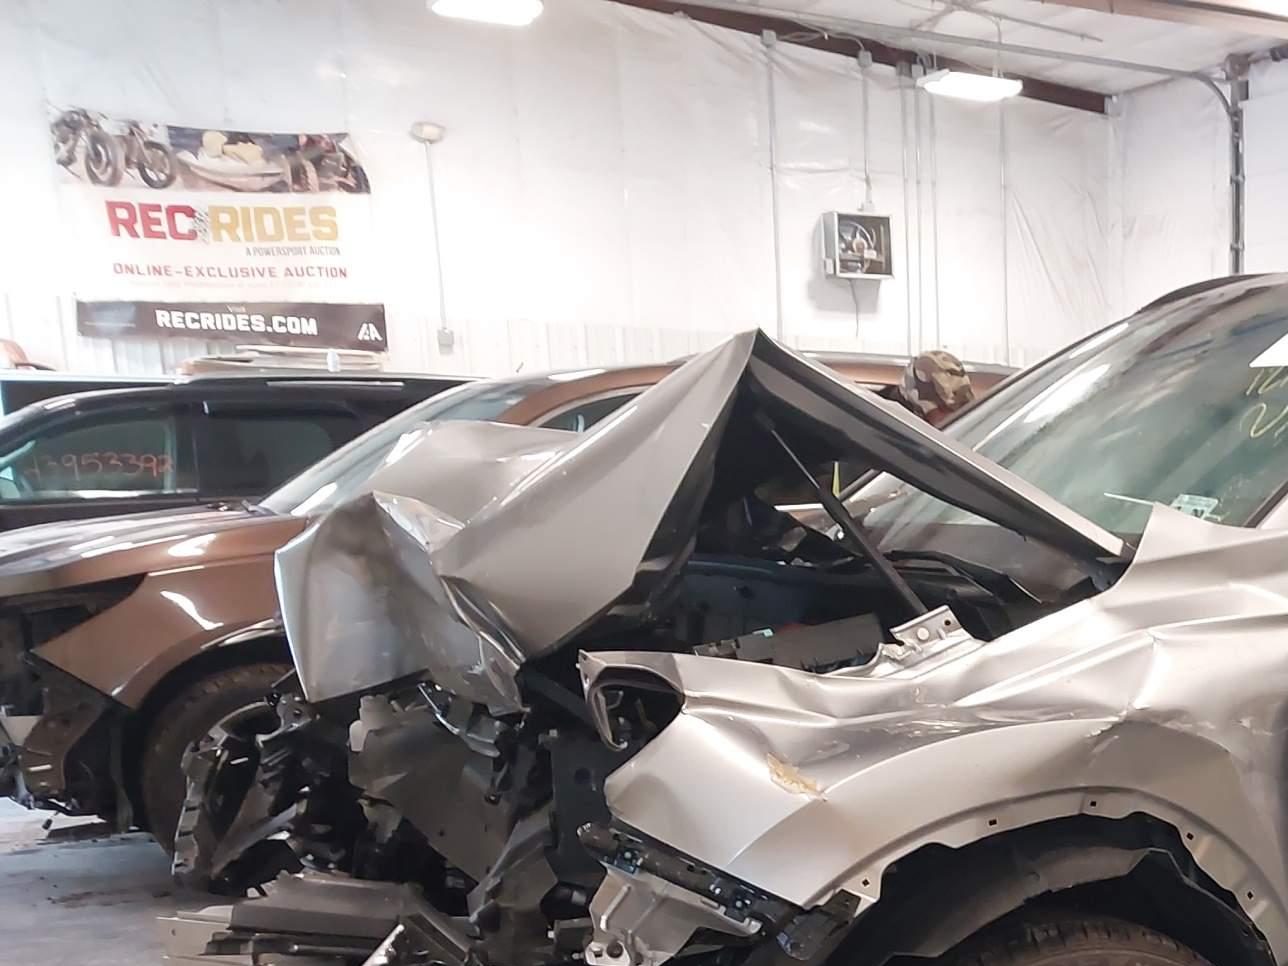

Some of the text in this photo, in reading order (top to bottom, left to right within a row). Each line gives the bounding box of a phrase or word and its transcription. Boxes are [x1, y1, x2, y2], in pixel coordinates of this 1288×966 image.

[106, 201, 339, 242] REC RIDES
[113, 262, 348, 279] ONLINE-EXCLUSIVE AUCTION
[155, 309, 318, 336] RECRIDES.COM
